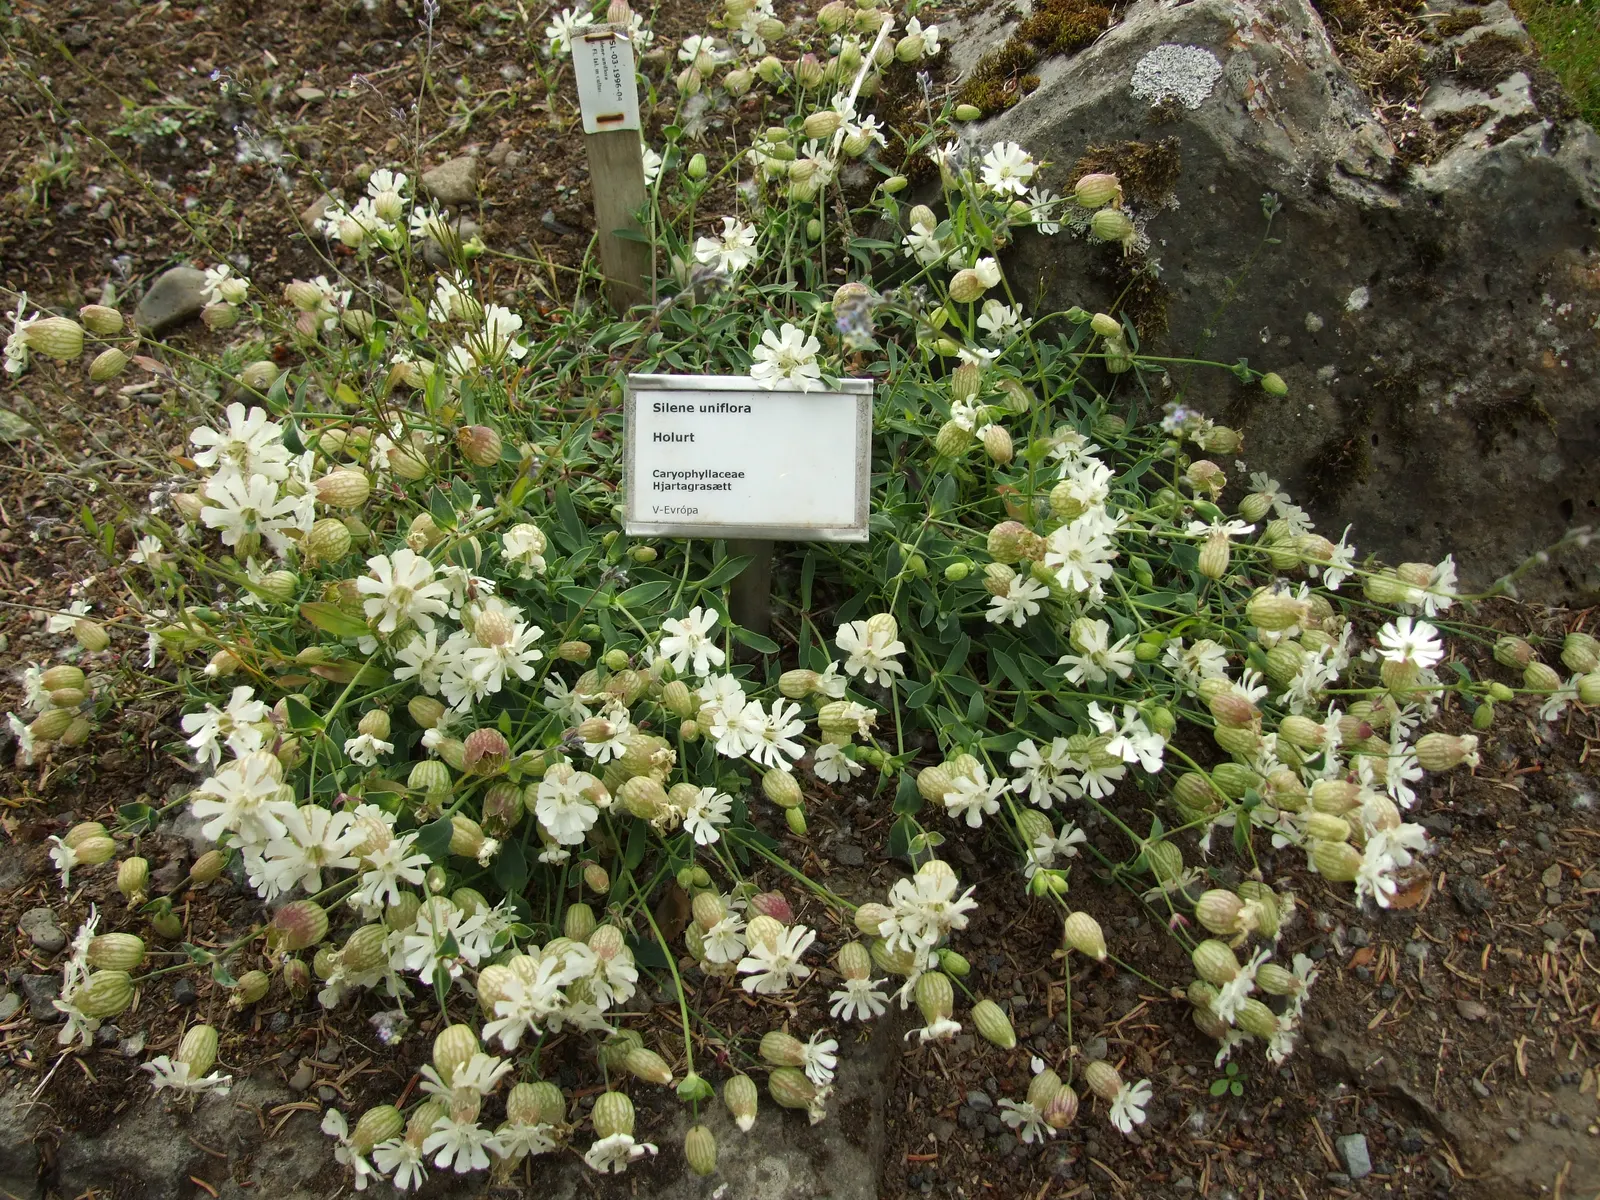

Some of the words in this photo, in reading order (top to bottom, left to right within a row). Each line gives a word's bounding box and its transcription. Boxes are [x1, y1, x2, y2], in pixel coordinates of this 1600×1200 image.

[653, 402, 694, 413] Silene
[699, 402, 751, 413] uniflora
[653, 432, 695, 443] Holurt
[653, 469, 744, 480] Caryophyllaceae
[653, 481, 732, 492] Hjartagrasætt
[653, 505, 699, 516] V-Evrópa
